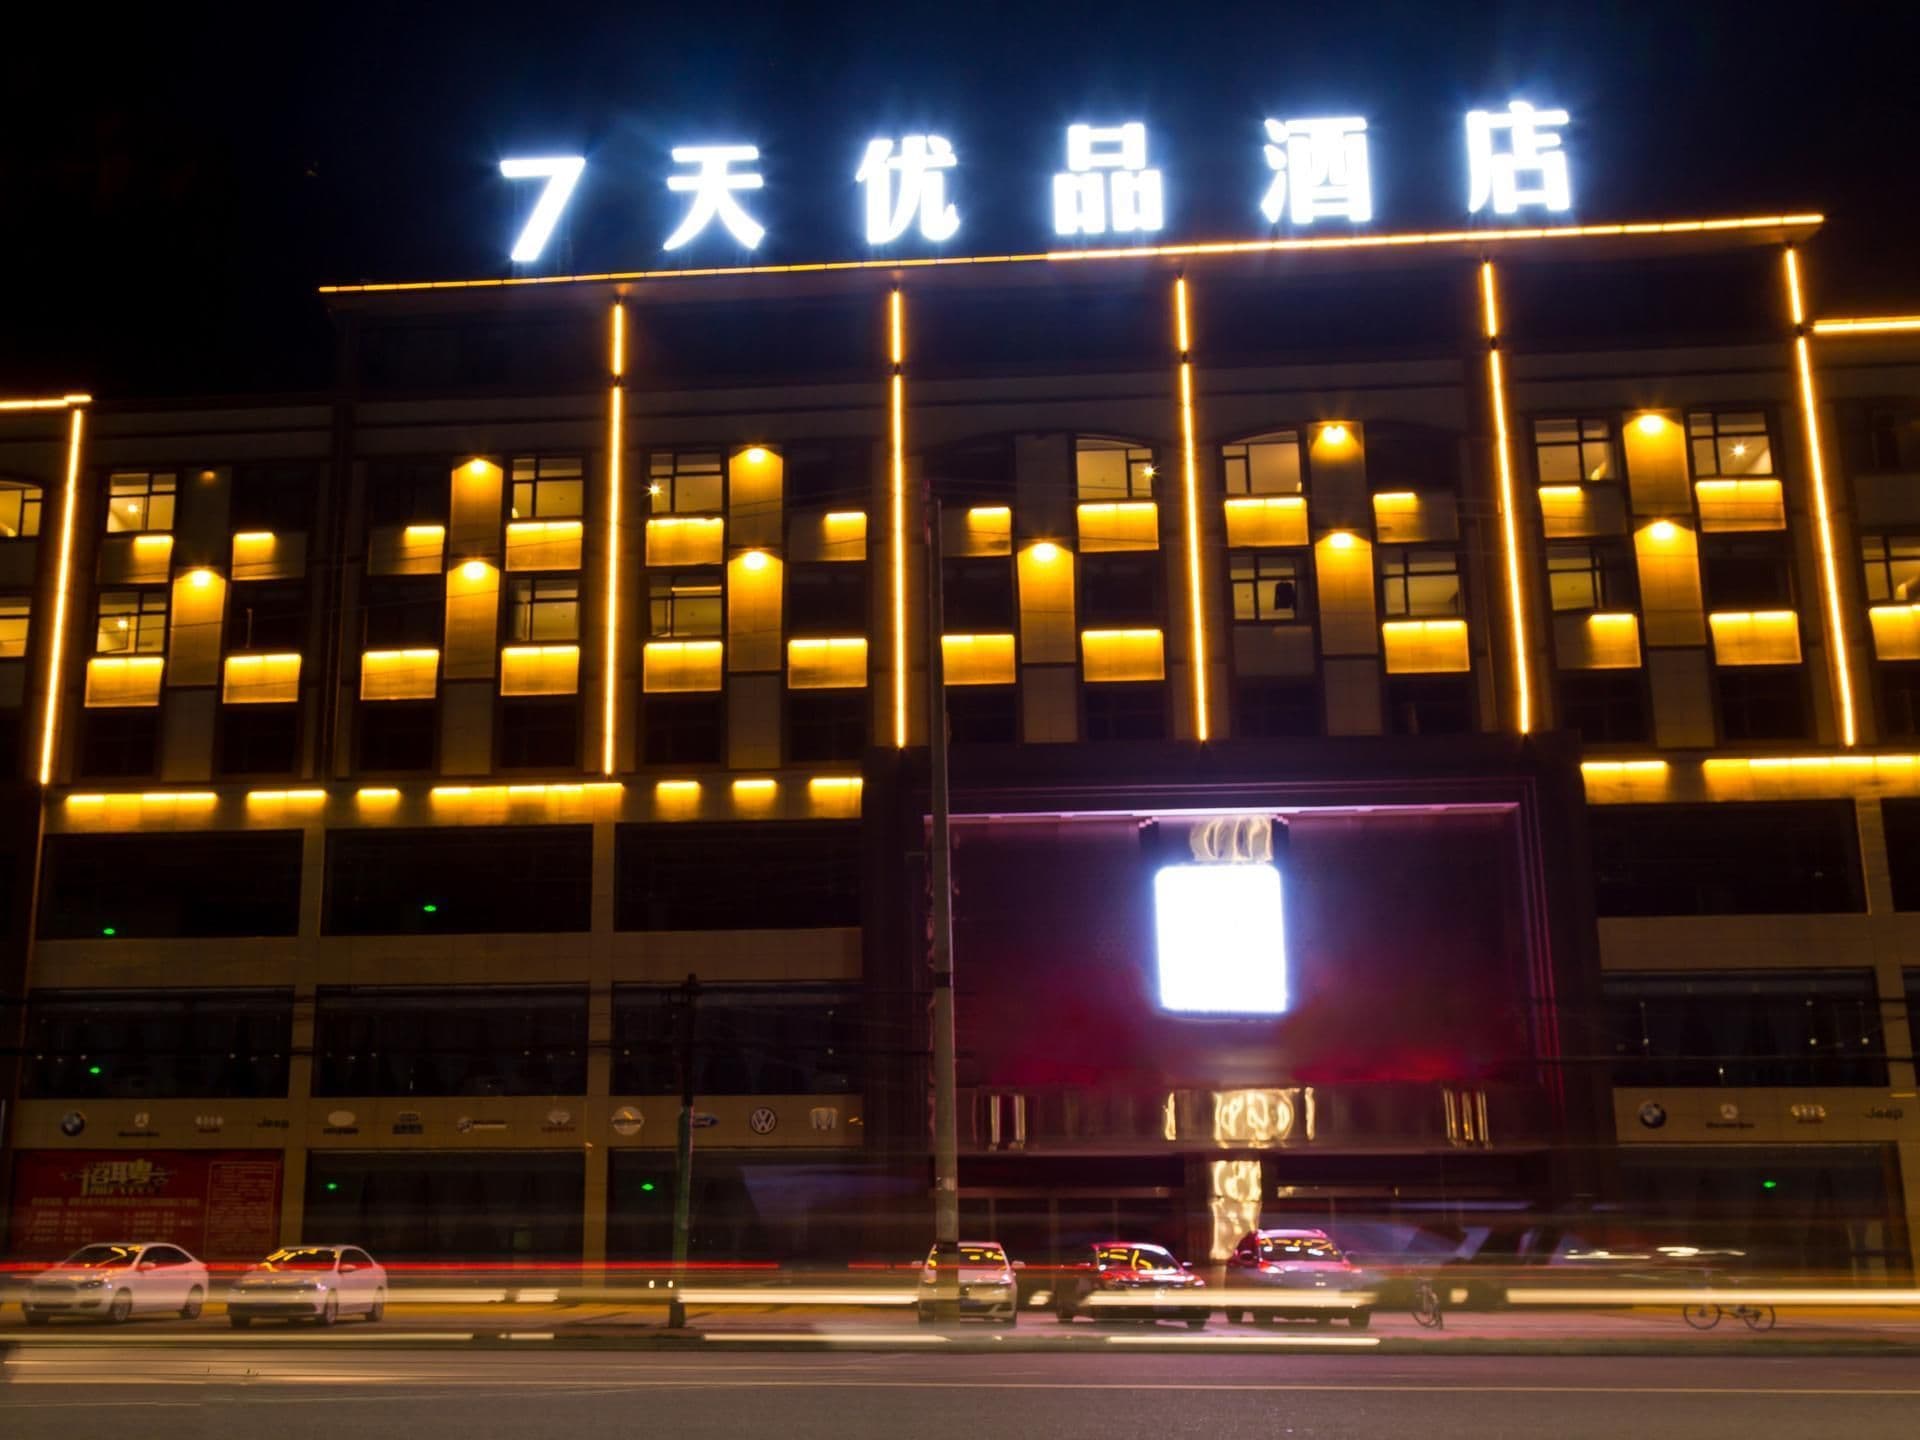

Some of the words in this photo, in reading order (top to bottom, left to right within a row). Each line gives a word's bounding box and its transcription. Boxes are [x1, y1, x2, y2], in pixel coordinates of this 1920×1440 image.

[498, 100, 1572, 264] 7天优品酒店
